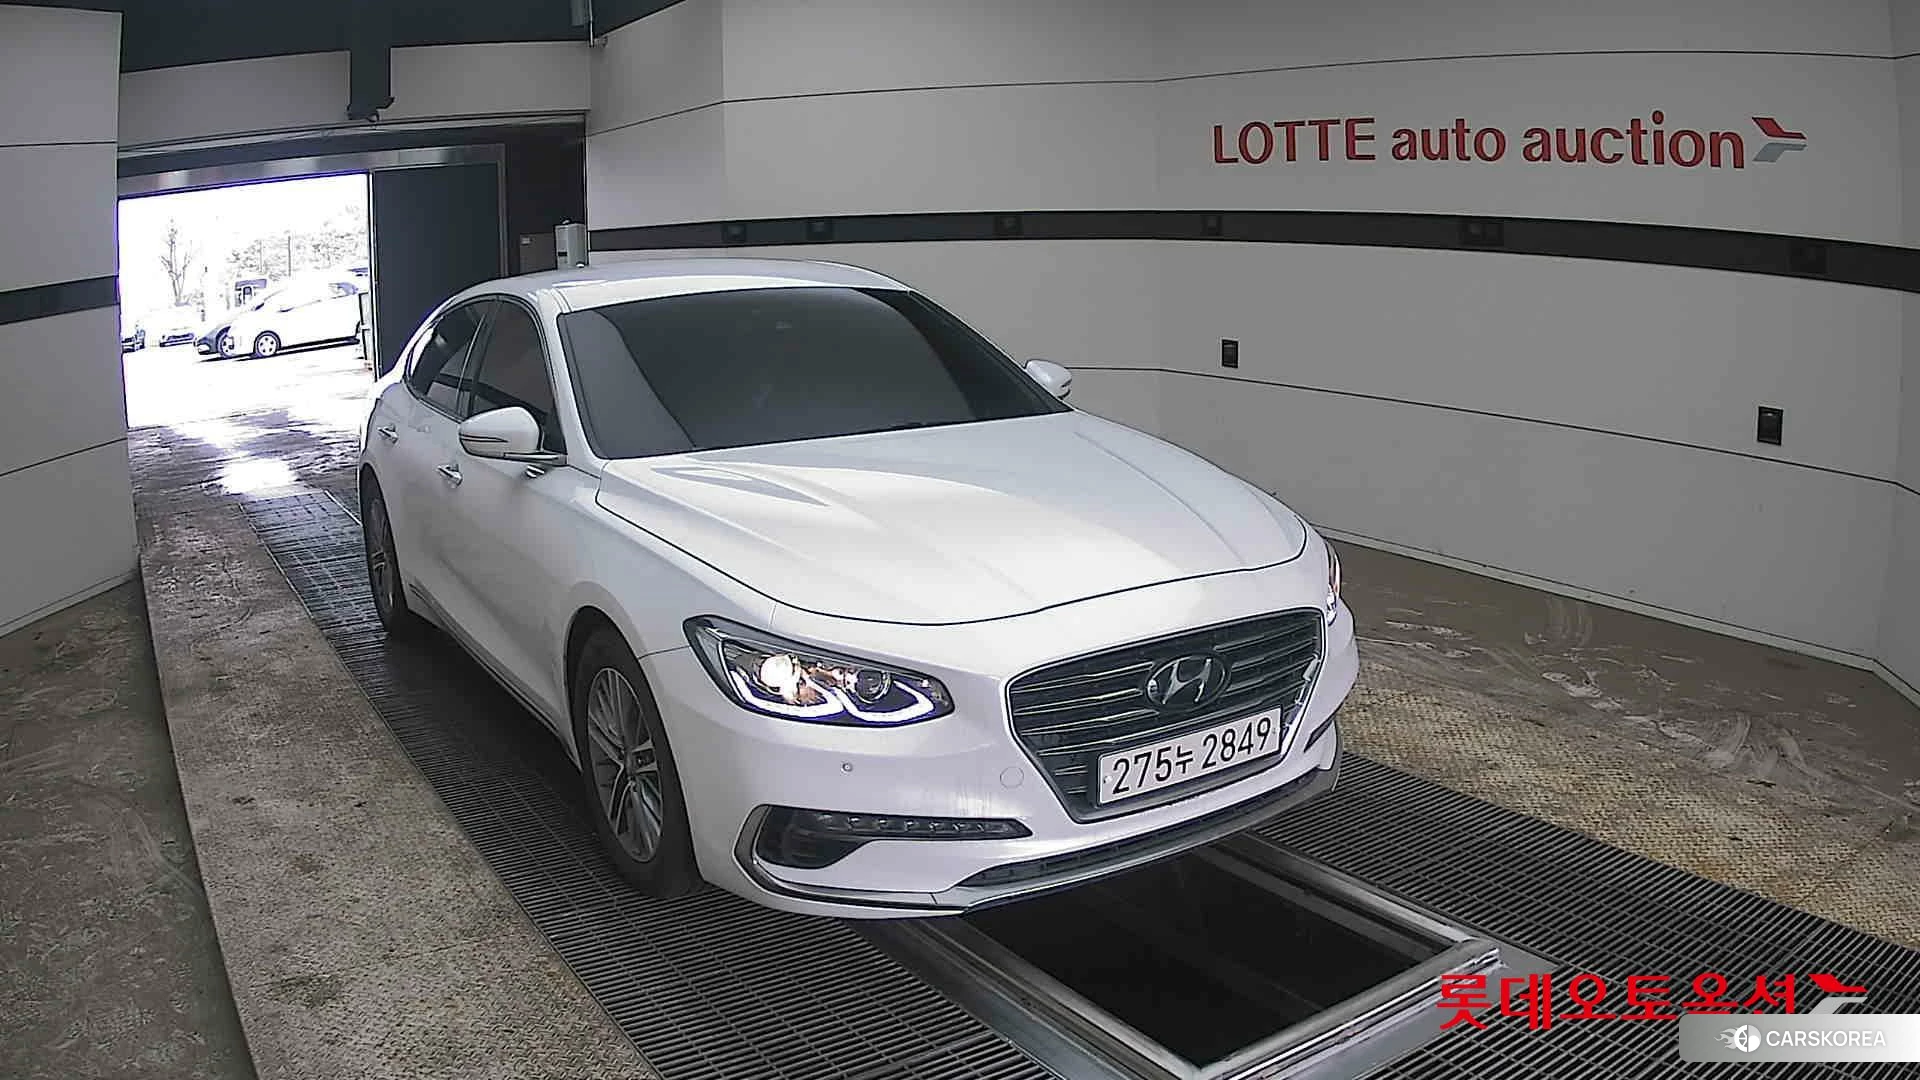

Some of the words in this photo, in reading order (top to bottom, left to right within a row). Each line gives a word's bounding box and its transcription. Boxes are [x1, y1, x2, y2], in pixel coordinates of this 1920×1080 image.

[1212, 117, 1376, 164] LOTTE
[1391, 117, 1507, 163] auto
[1522, 110, 1746, 169] auction
[1112, 745, 1194, 795] 275누
[1202, 717, 1272, 769] 2849
